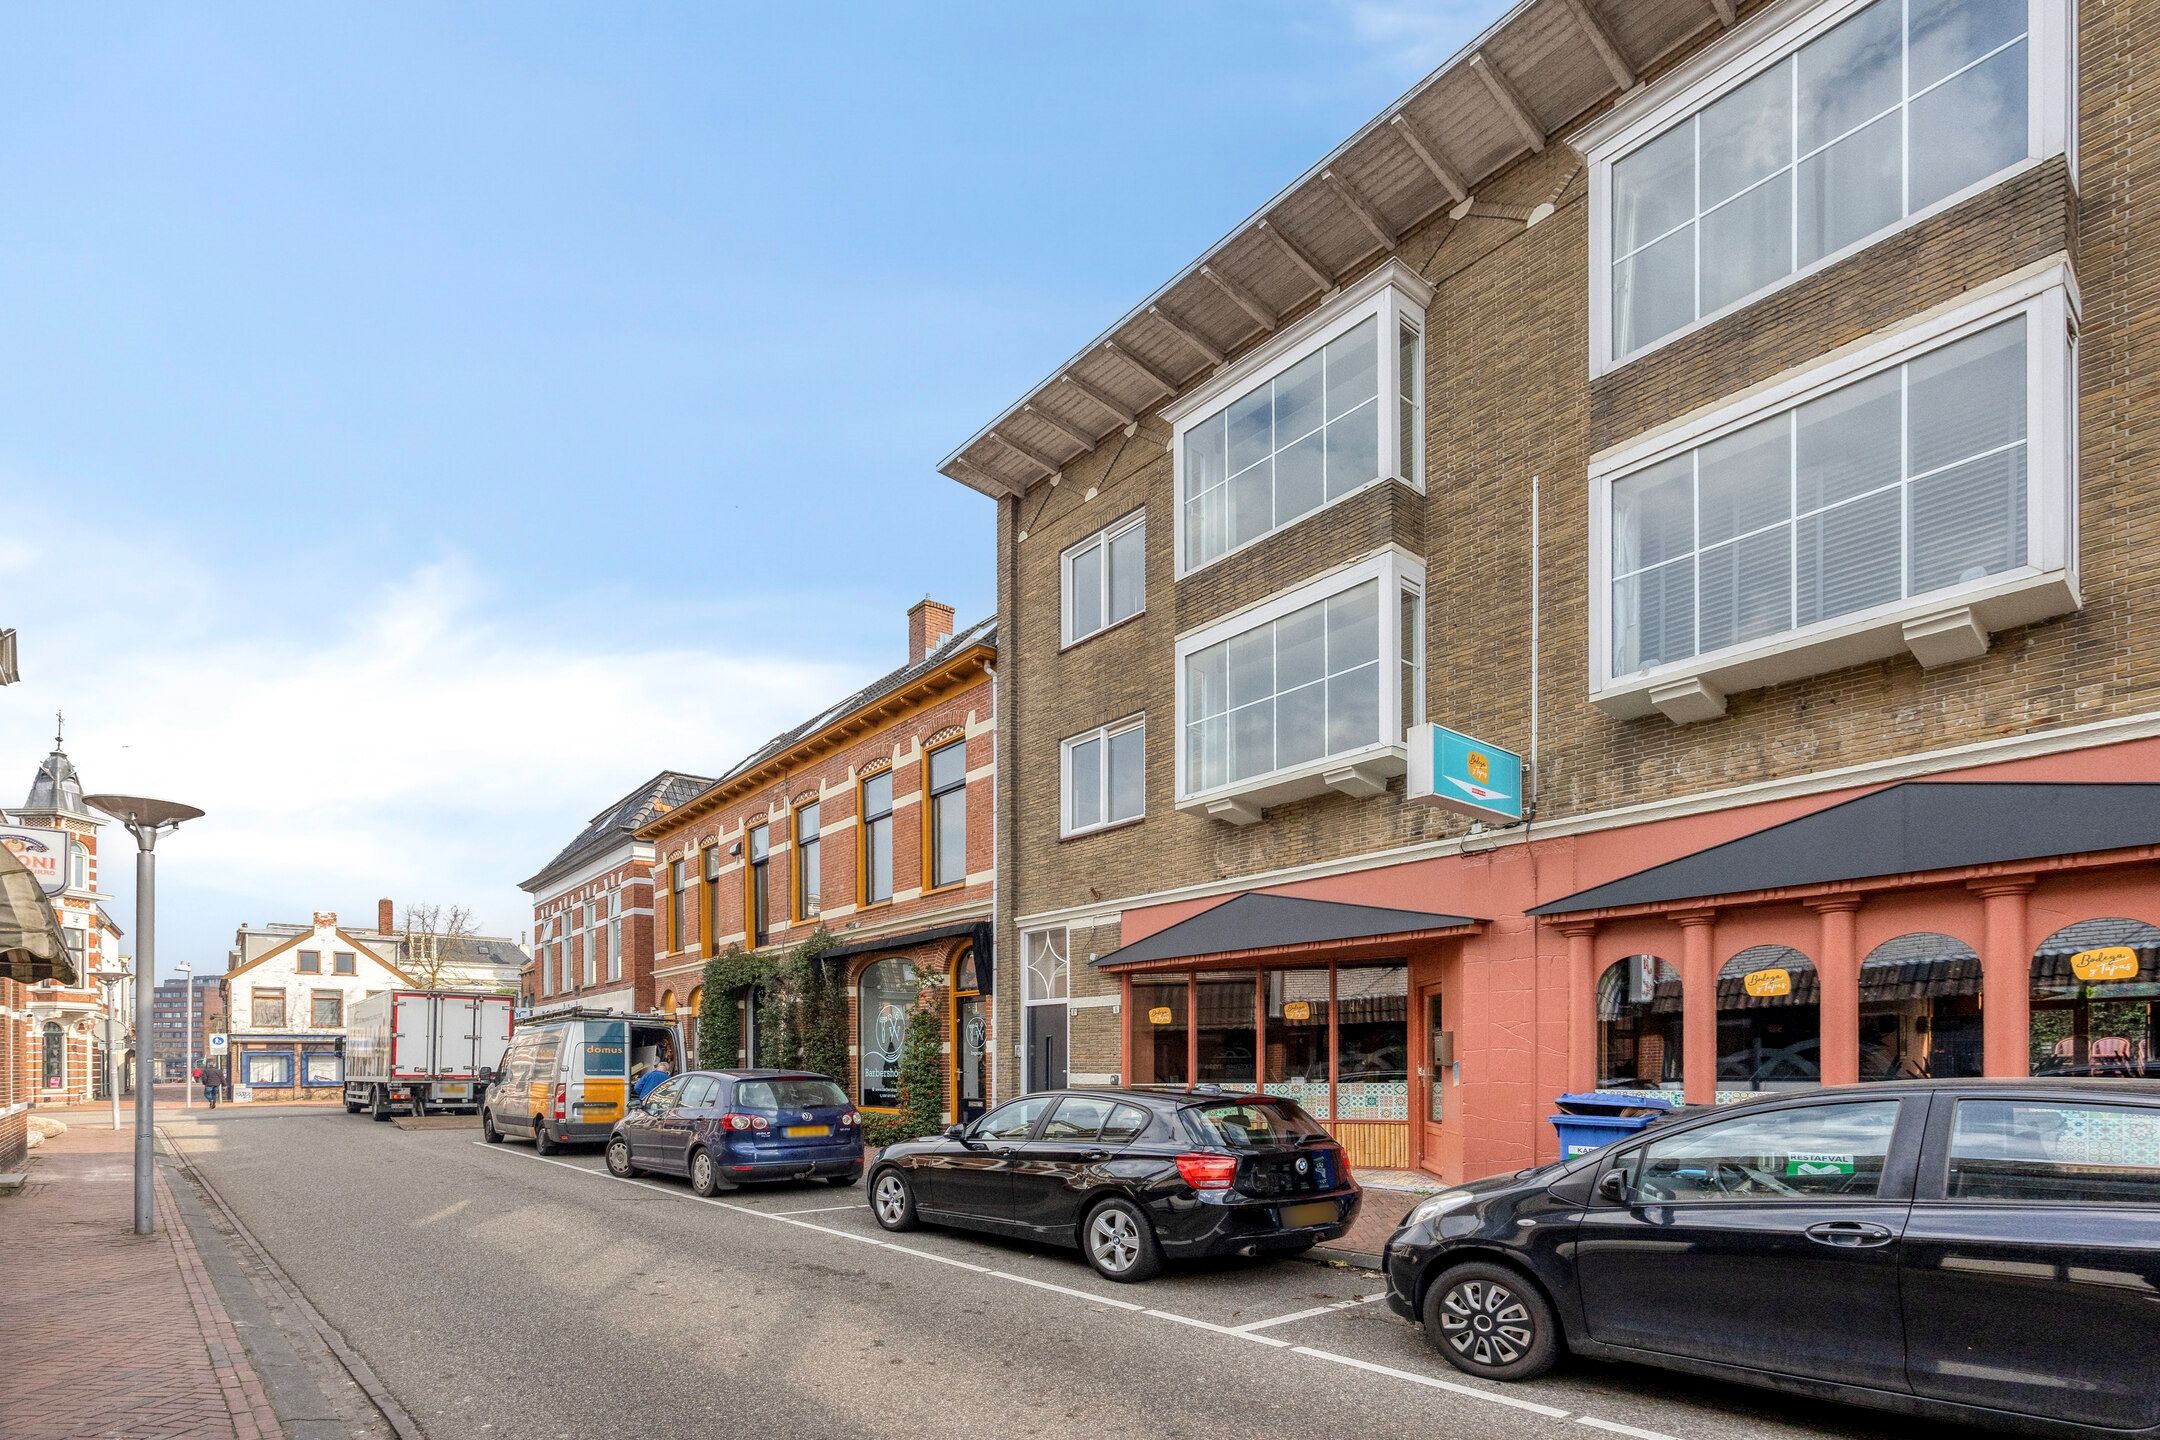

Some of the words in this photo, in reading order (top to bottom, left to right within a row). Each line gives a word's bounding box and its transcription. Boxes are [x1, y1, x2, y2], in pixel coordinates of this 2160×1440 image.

[2076, 952, 2126, 967] Bodega
[2096, 957, 2132, 976] Tapas
[1747, 973, 1783, 986] Bodega
[1762, 977, 1787, 993] Tapas
[586, 1045, 623, 1053] domus
[865, 1068, 902, 1077] Barbersho
[1790, 1154, 1849, 1163] RESTAFVAL
